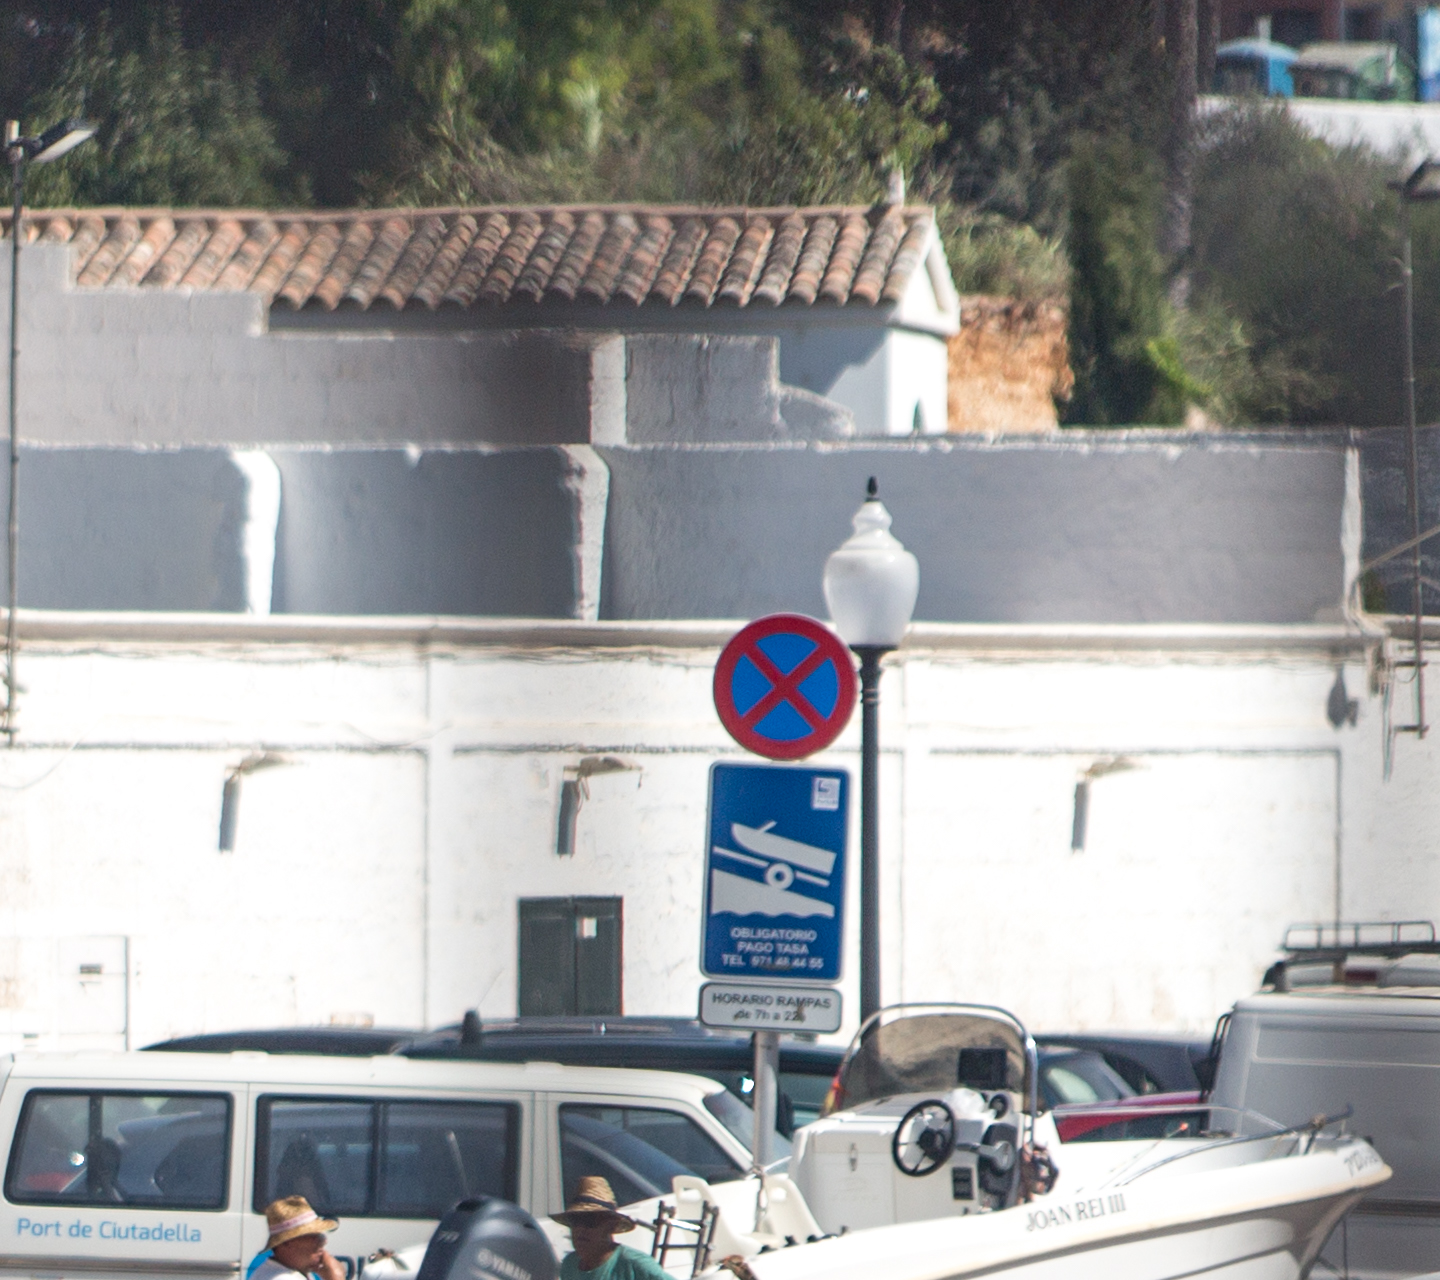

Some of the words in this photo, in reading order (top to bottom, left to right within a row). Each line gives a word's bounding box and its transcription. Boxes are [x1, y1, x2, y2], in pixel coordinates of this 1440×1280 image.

[730, 926, 817, 942] OBLIGATORIO
[737, 941, 774, 954] PAGO
[776, 943, 809, 955] TASA
[722, 954, 745, 966] TEL
[712, 992, 774, 1006] HORARIO
[776, 995, 831, 1009] RAMPAS
[1026, 1204, 1072, 1231] JOAN
[1075, 1198, 1105, 1220] REI
[17, 1218, 62, 1237] Port
[68, 1220, 92, 1237] de
[99, 1221, 202, 1242] Ciutadella
